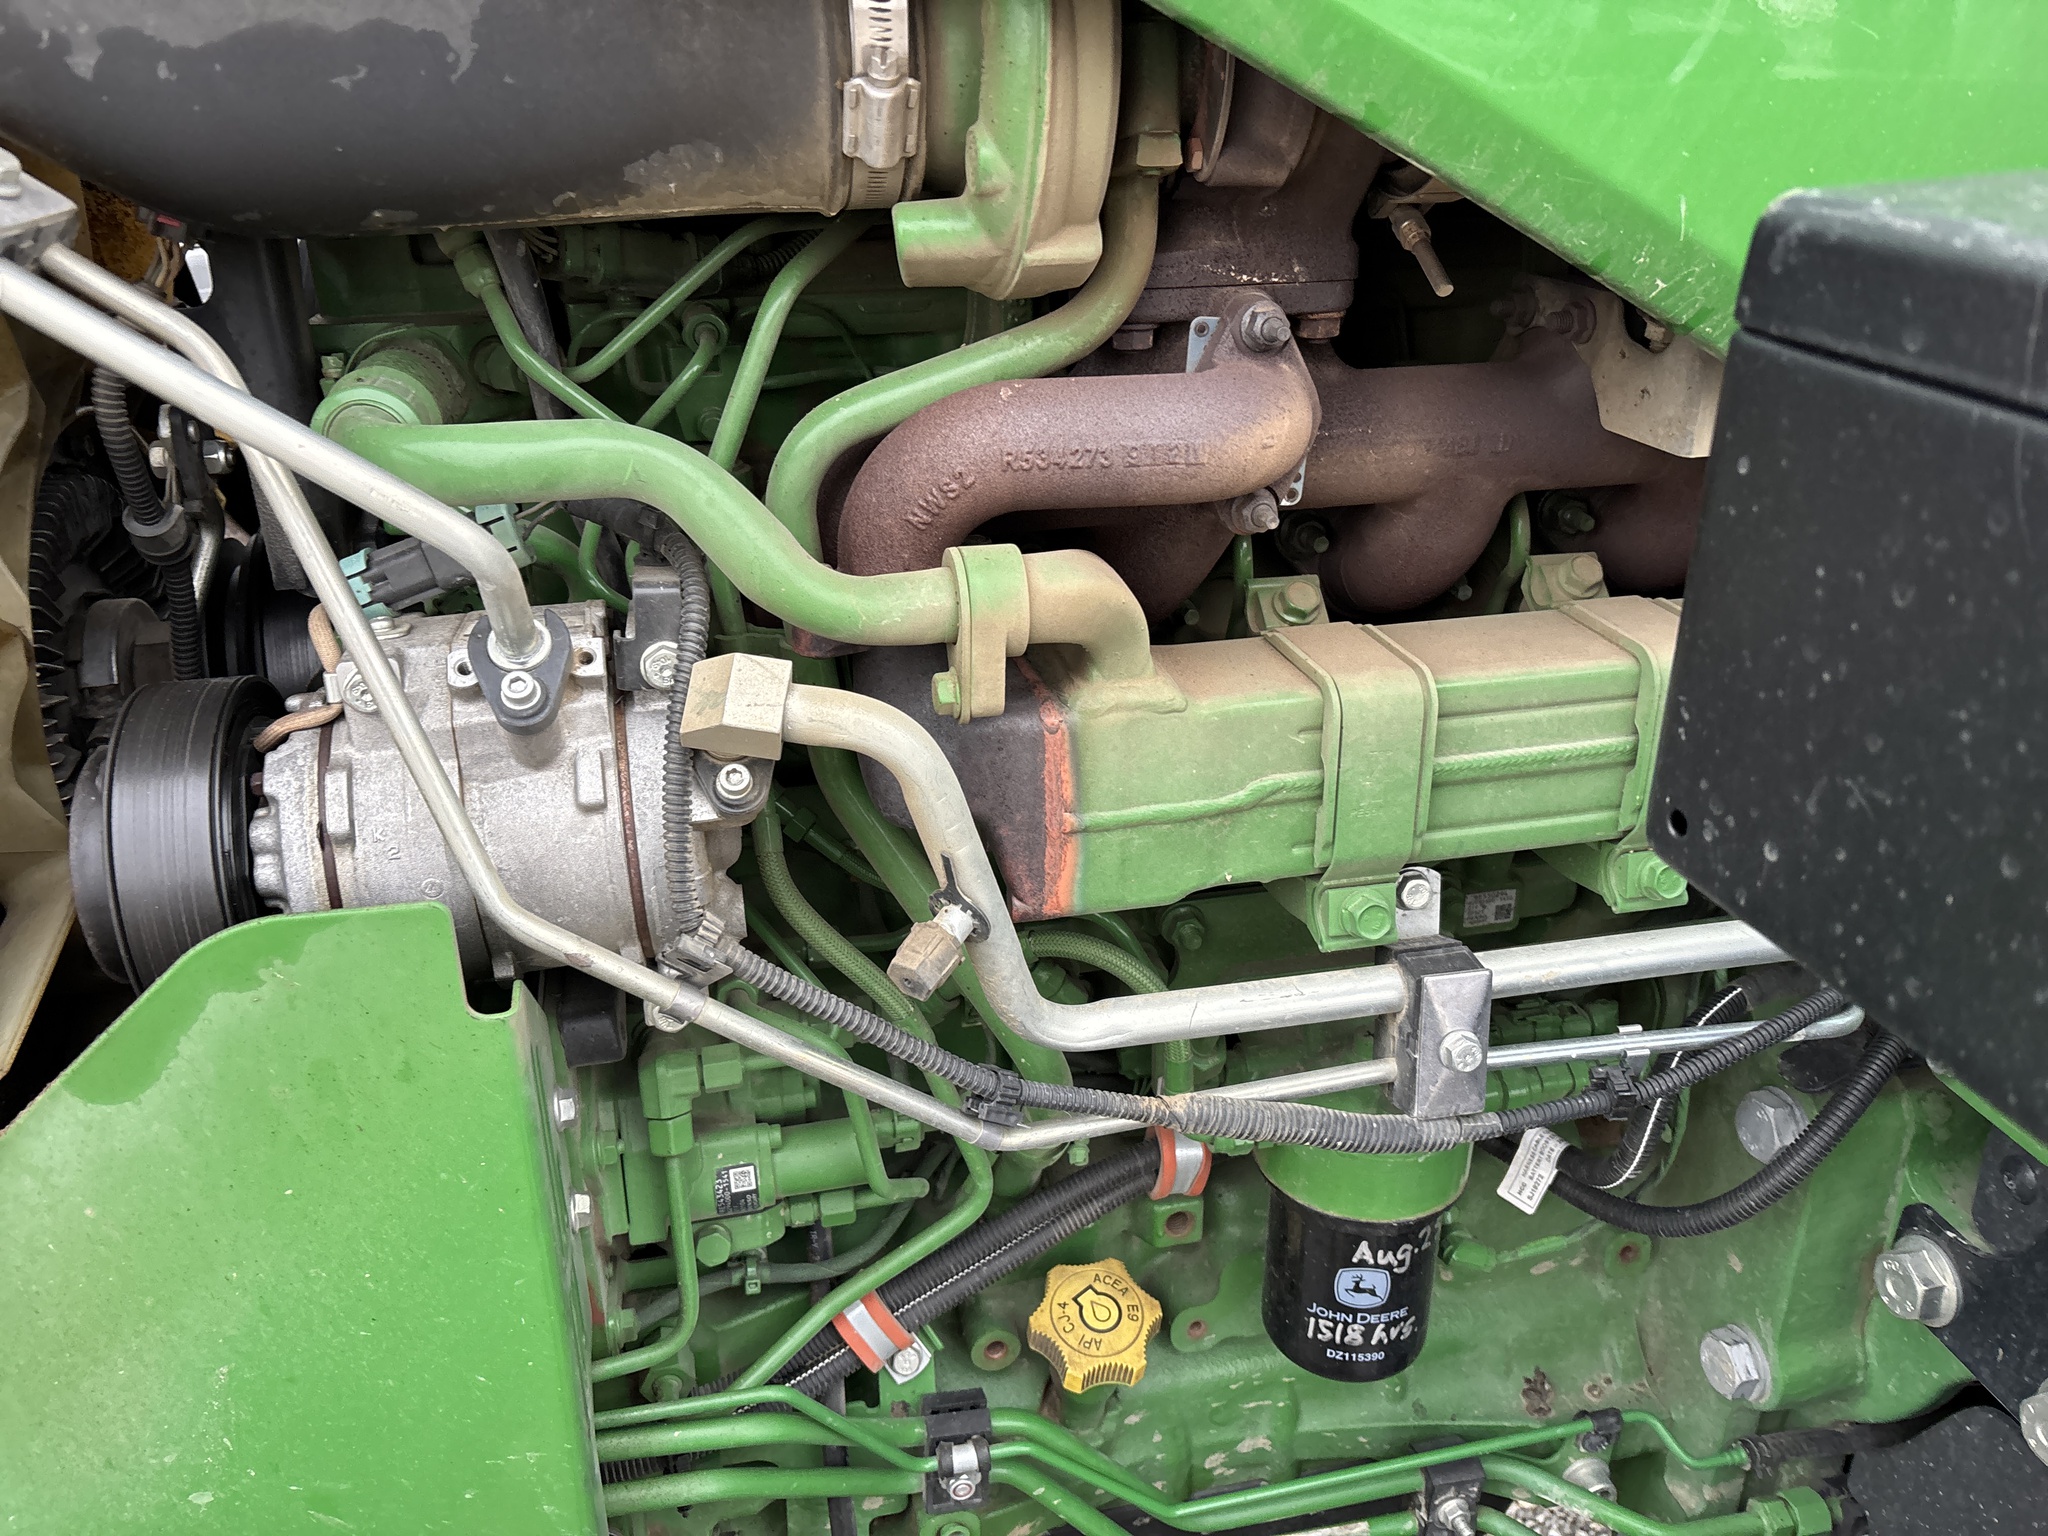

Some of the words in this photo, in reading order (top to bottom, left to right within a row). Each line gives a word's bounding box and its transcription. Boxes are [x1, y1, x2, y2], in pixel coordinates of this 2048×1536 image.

[1093, 1273, 1129, 1297] ACEA
[1126, 1304, 1140, 1322] E9
[1057, 1301, 1075, 1334] CJ-4
[1306, 1302, 1353, 1324] JOHN
[1356, 1307, 1409, 1325] DEERE
[1078, 1334, 1102, 1351] API
[1306, 1316, 1366, 1346] 1518
[1326, 1348, 1386, 1362] DZ115390
